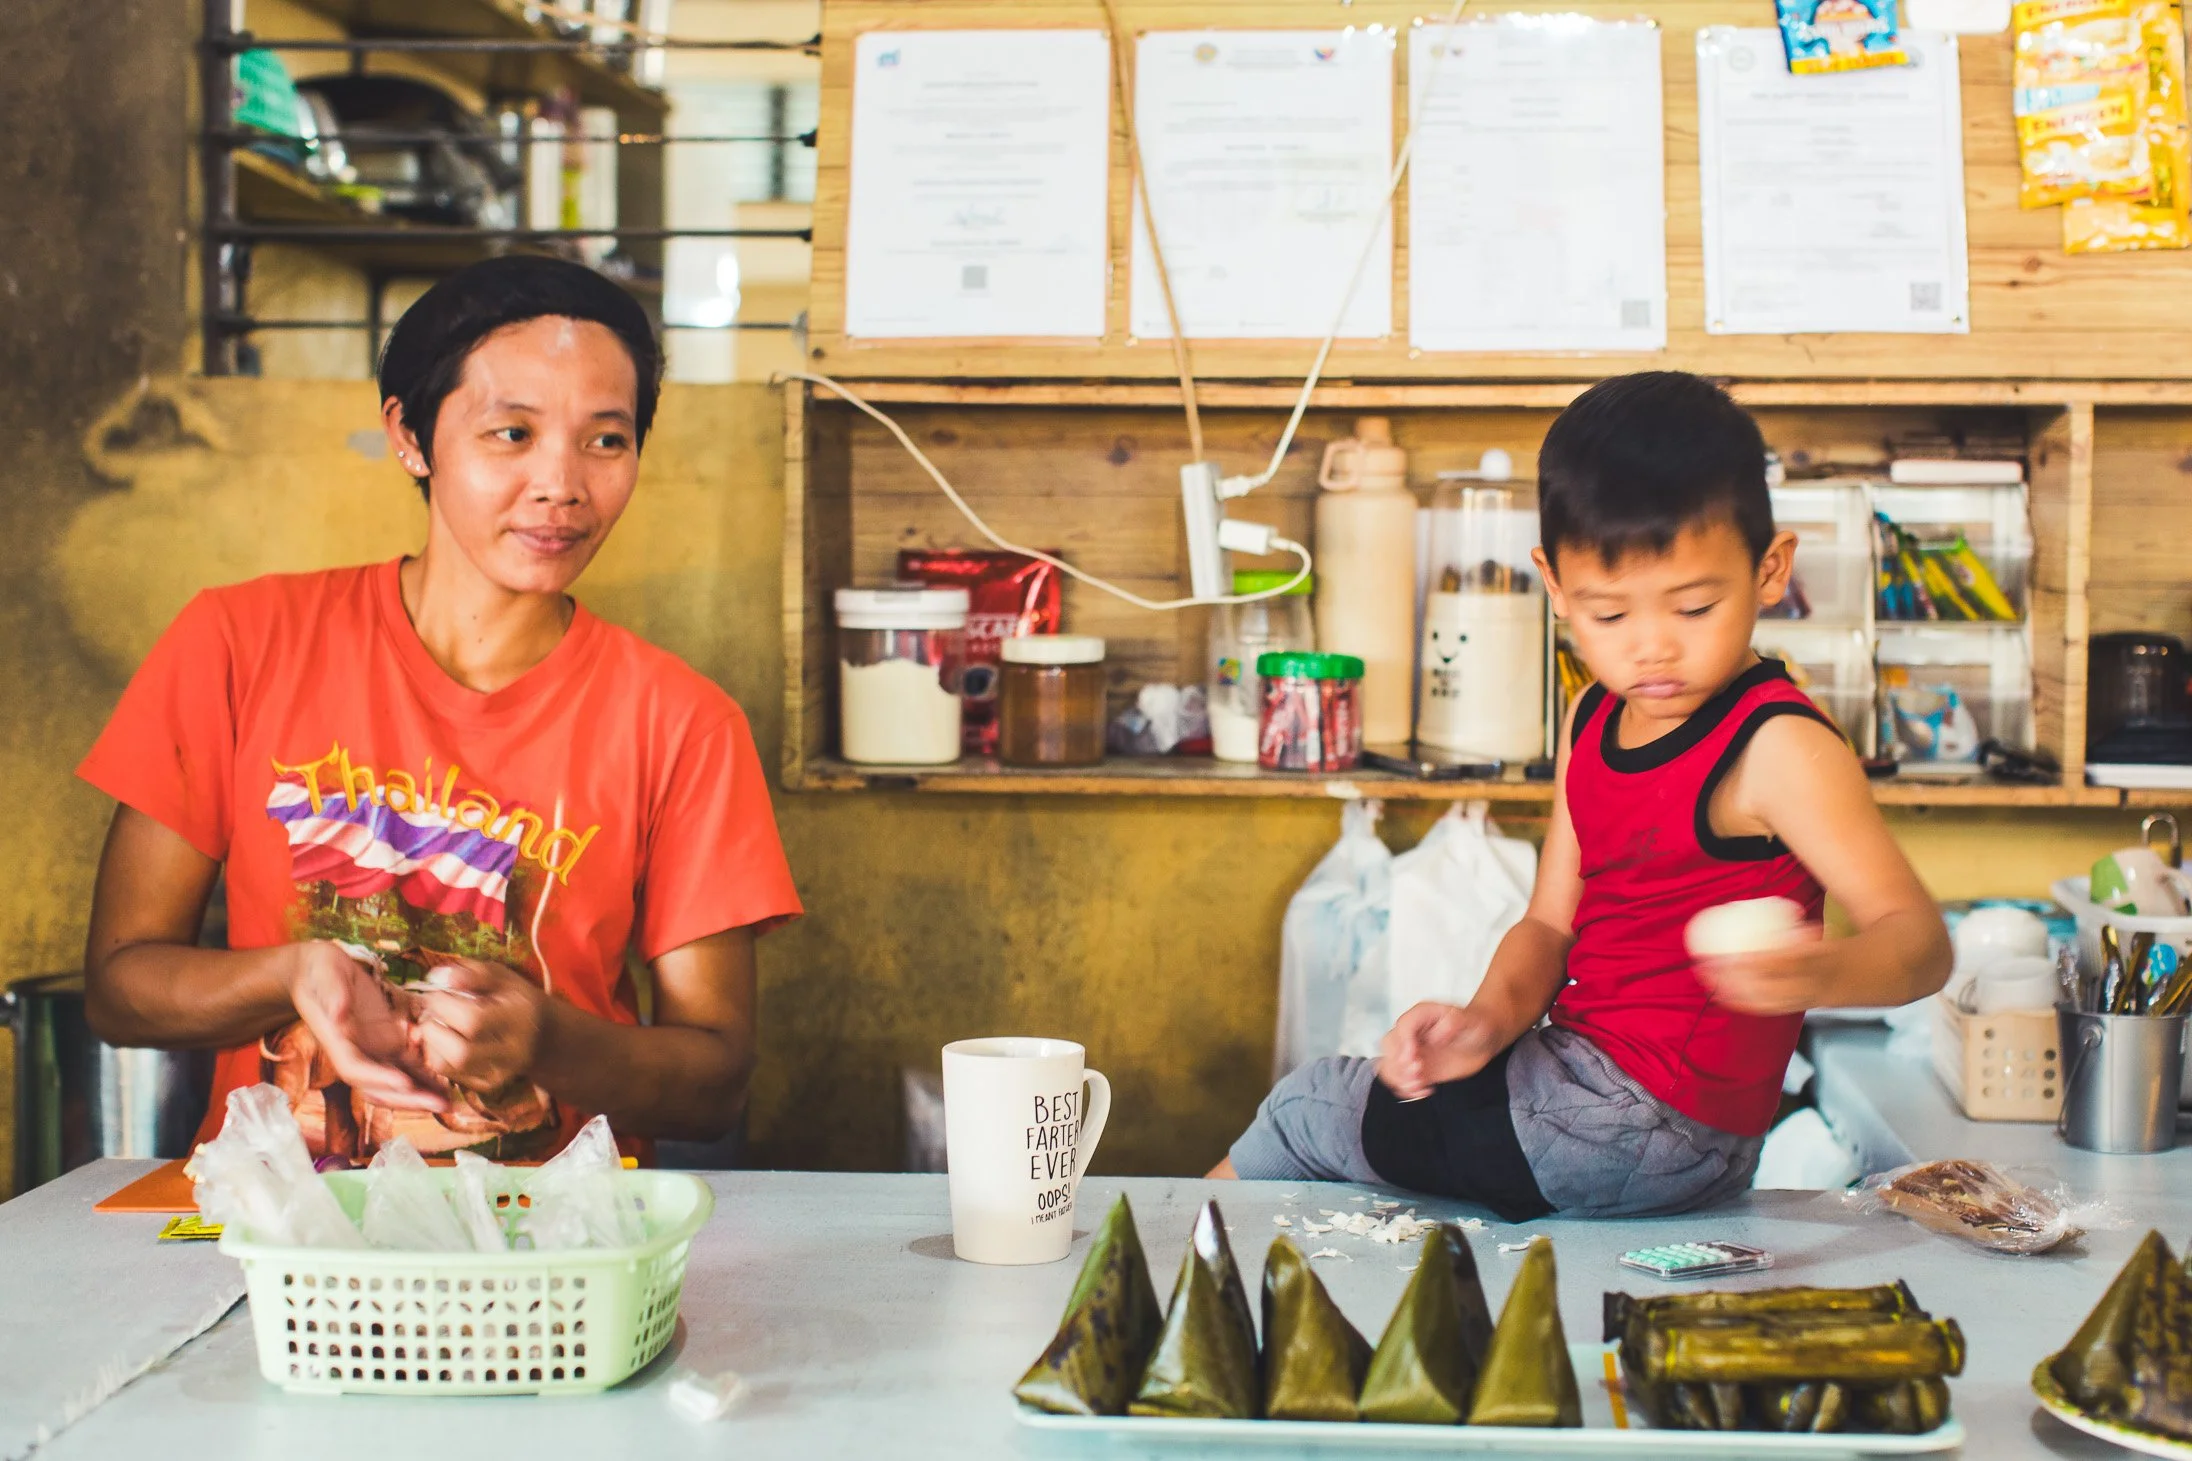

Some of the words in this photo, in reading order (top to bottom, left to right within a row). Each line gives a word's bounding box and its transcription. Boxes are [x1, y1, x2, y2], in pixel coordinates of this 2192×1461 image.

[271, 740, 601, 886] Thailand
[1034, 1091, 1079, 1124] BEST
[1026, 1119, 1080, 1151] FARTER
[1031, 1147, 1077, 1180] EVER
[1037, 1182, 1071, 1211] OOPS!
[1030, 1216, 1034, 1225] I
[1035, 1210, 1057, 1223] MEANT
